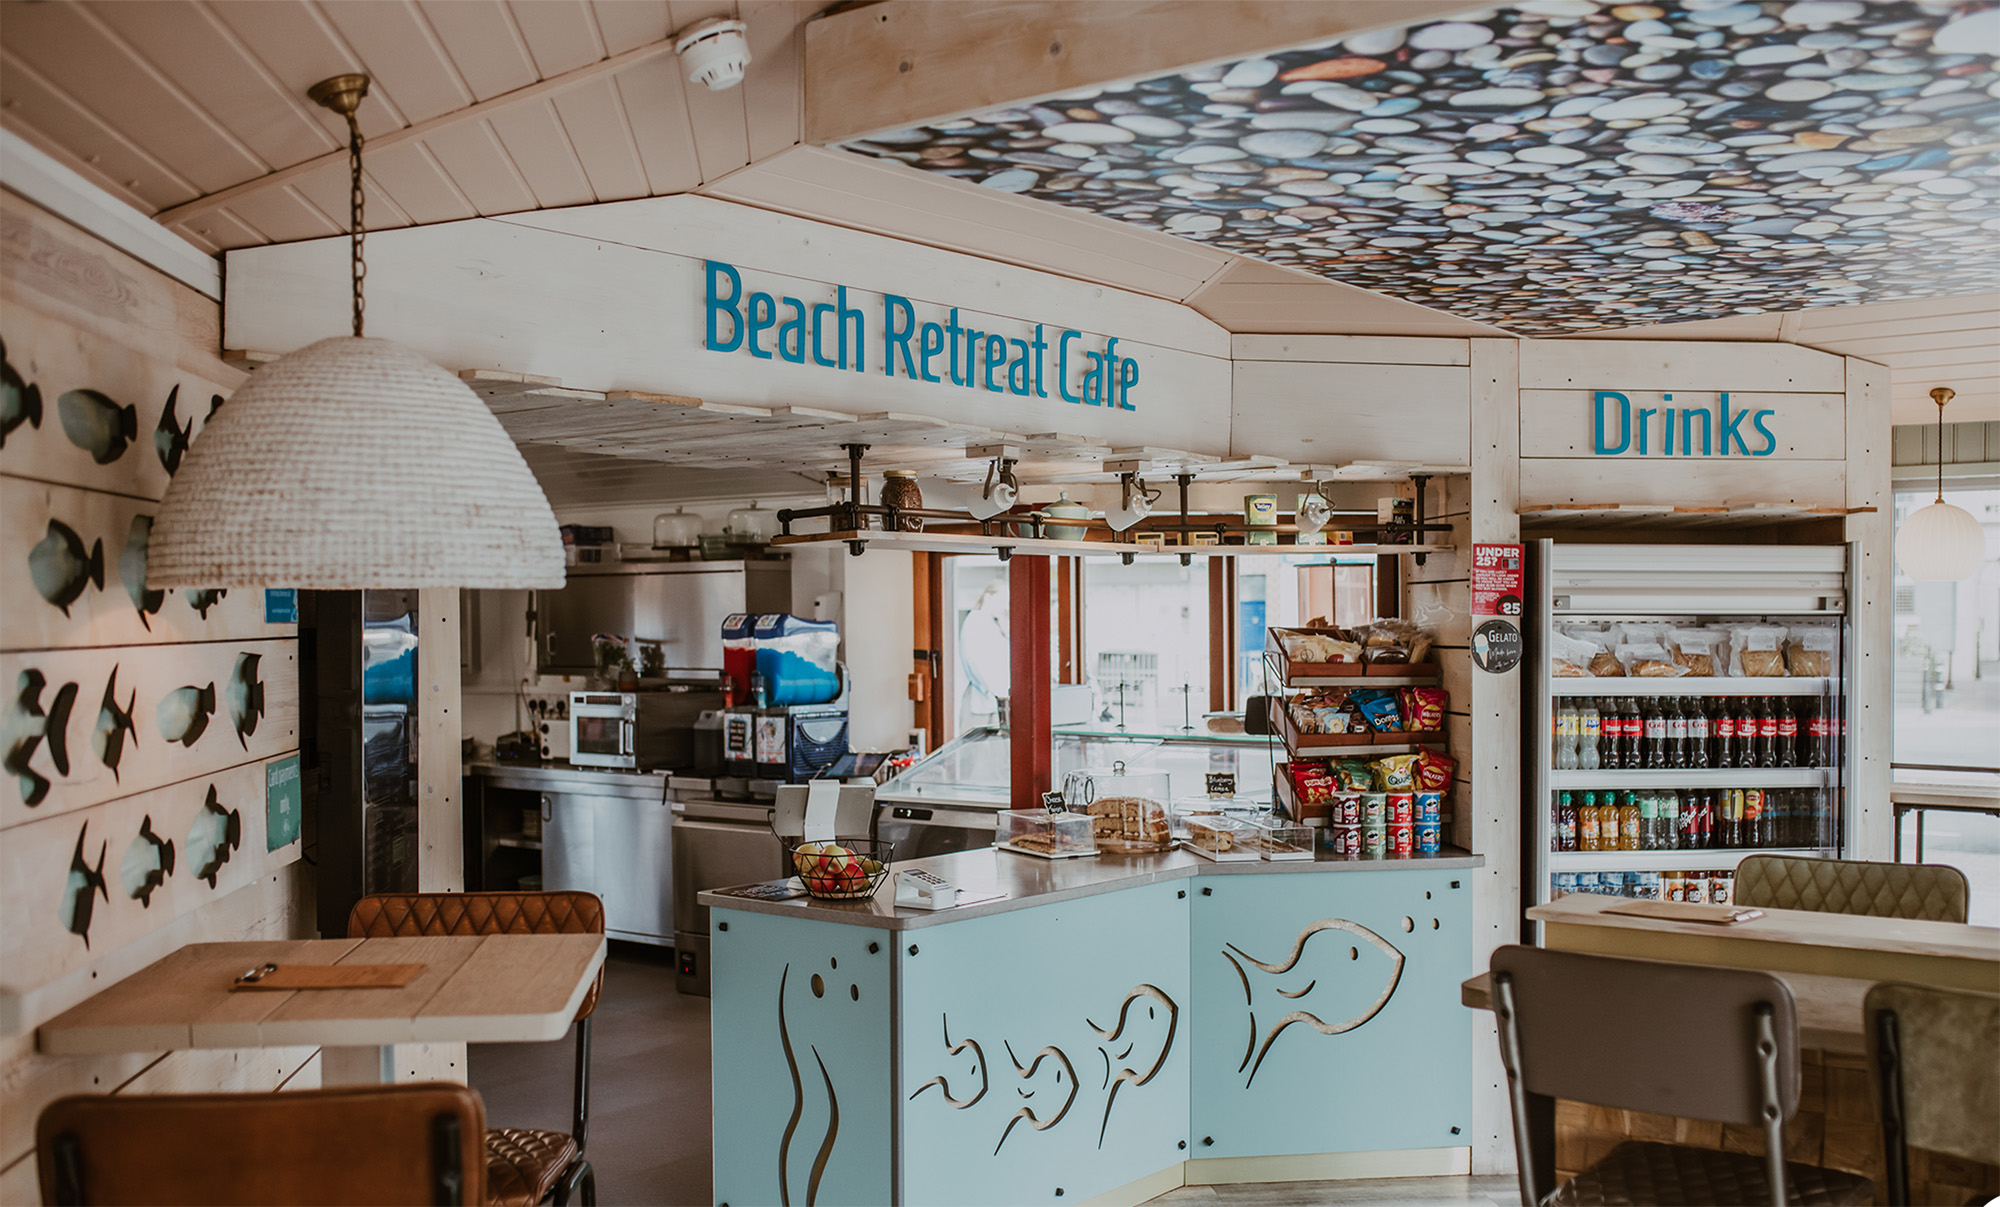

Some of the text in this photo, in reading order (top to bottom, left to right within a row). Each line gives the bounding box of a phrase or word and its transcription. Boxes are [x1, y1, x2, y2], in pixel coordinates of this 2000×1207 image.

[706, 259, 1139, 412] Beach Retreat Cafe
[1594, 391, 1776, 456] Drinks
[1476, 547, 1520, 557] UNDER
[1475, 556, 1498, 566] 25?
[1502, 602, 1521, 614] 25
[1488, 630, 1518, 643] GELATO
[1374, 713, 1400, 726] Doritos
